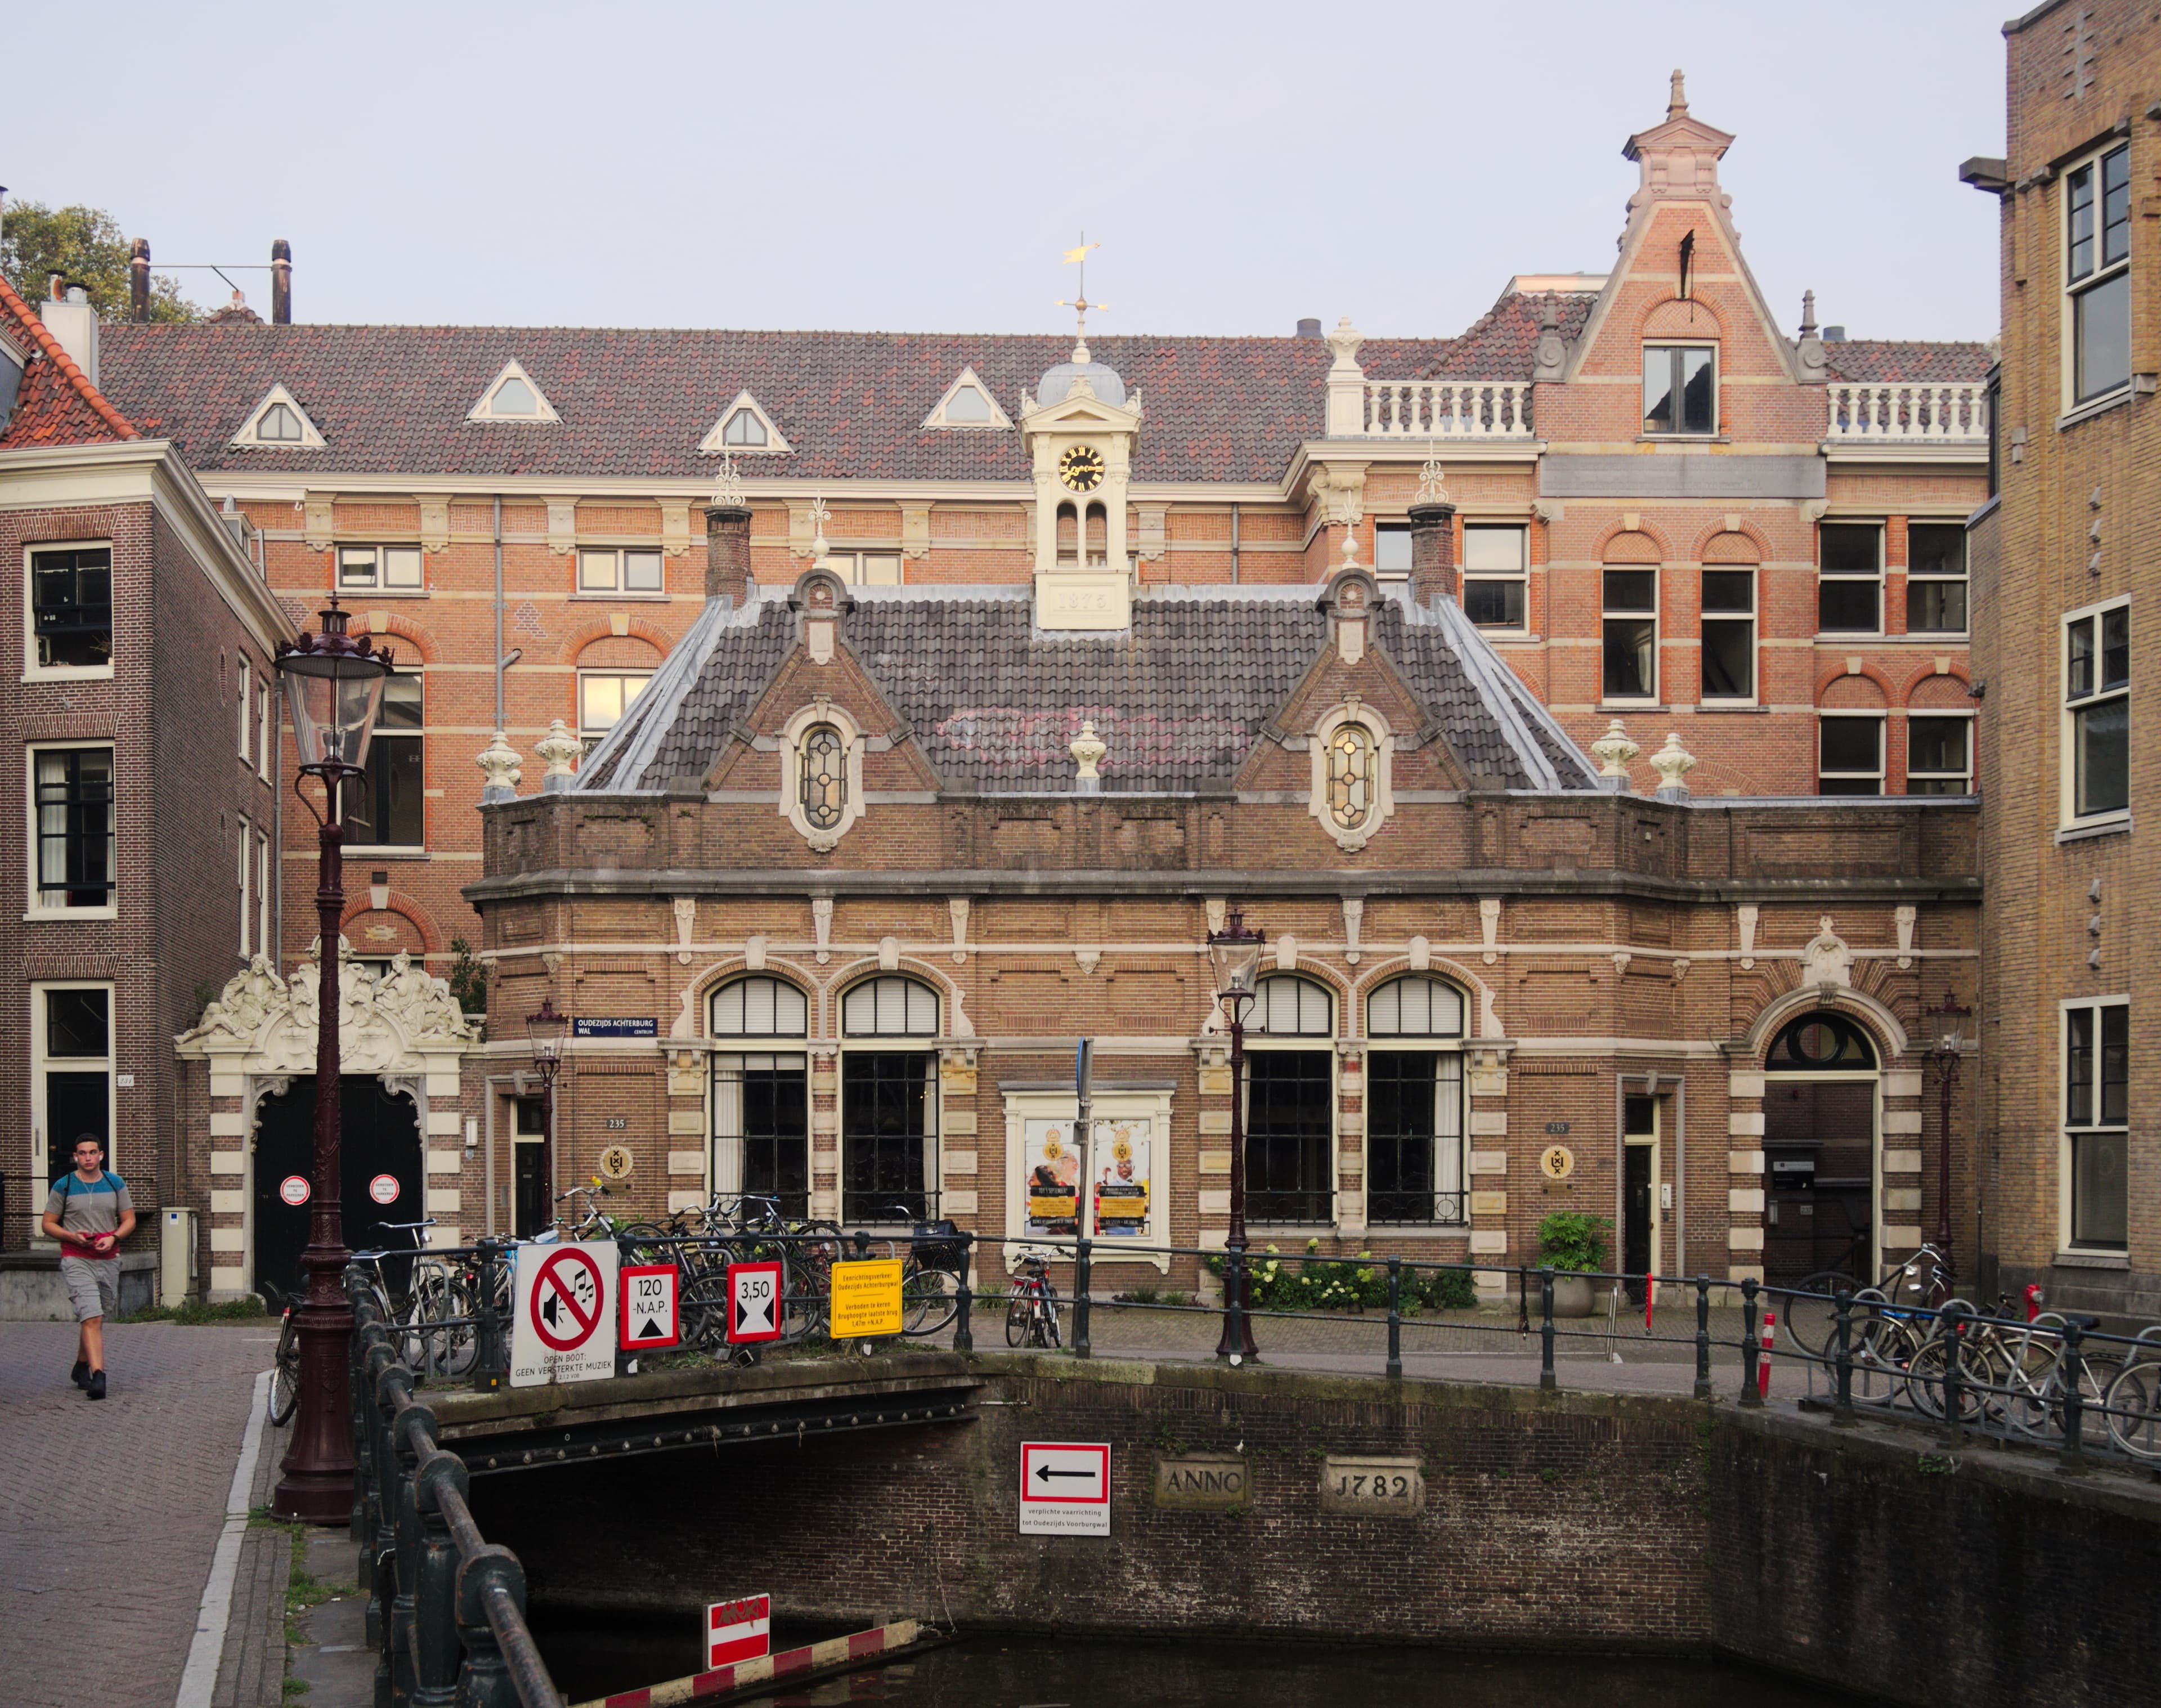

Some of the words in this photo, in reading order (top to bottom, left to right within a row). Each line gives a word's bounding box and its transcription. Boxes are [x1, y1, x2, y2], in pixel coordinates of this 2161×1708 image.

[578, 1019, 612, 1028] OUDEZIJDS
[609, 1119, 625, 1128] 235
[1550, 1124, 1565, 1132] 235
[843, 1273, 893, 1282] Eenrichtingsverkeer
[638, 1279, 662, 1297] 120
[863, 1280, 898, 1289] Achterburgwal
[741, 1280, 769, 1302] 3,50
[838, 1312, 867, 1321] Brughoogte
[544, 1355, 563, 1364] OPEN
[566, 1353, 586, 1362] BOOT:
[515, 1369, 535, 1377] GEEN
[538, 1364, 583, 1375] VERSTERKTE
[586, 1361, 612, 1370] MUZIEK
[1167, 1470, 1243, 1493] ANNO
